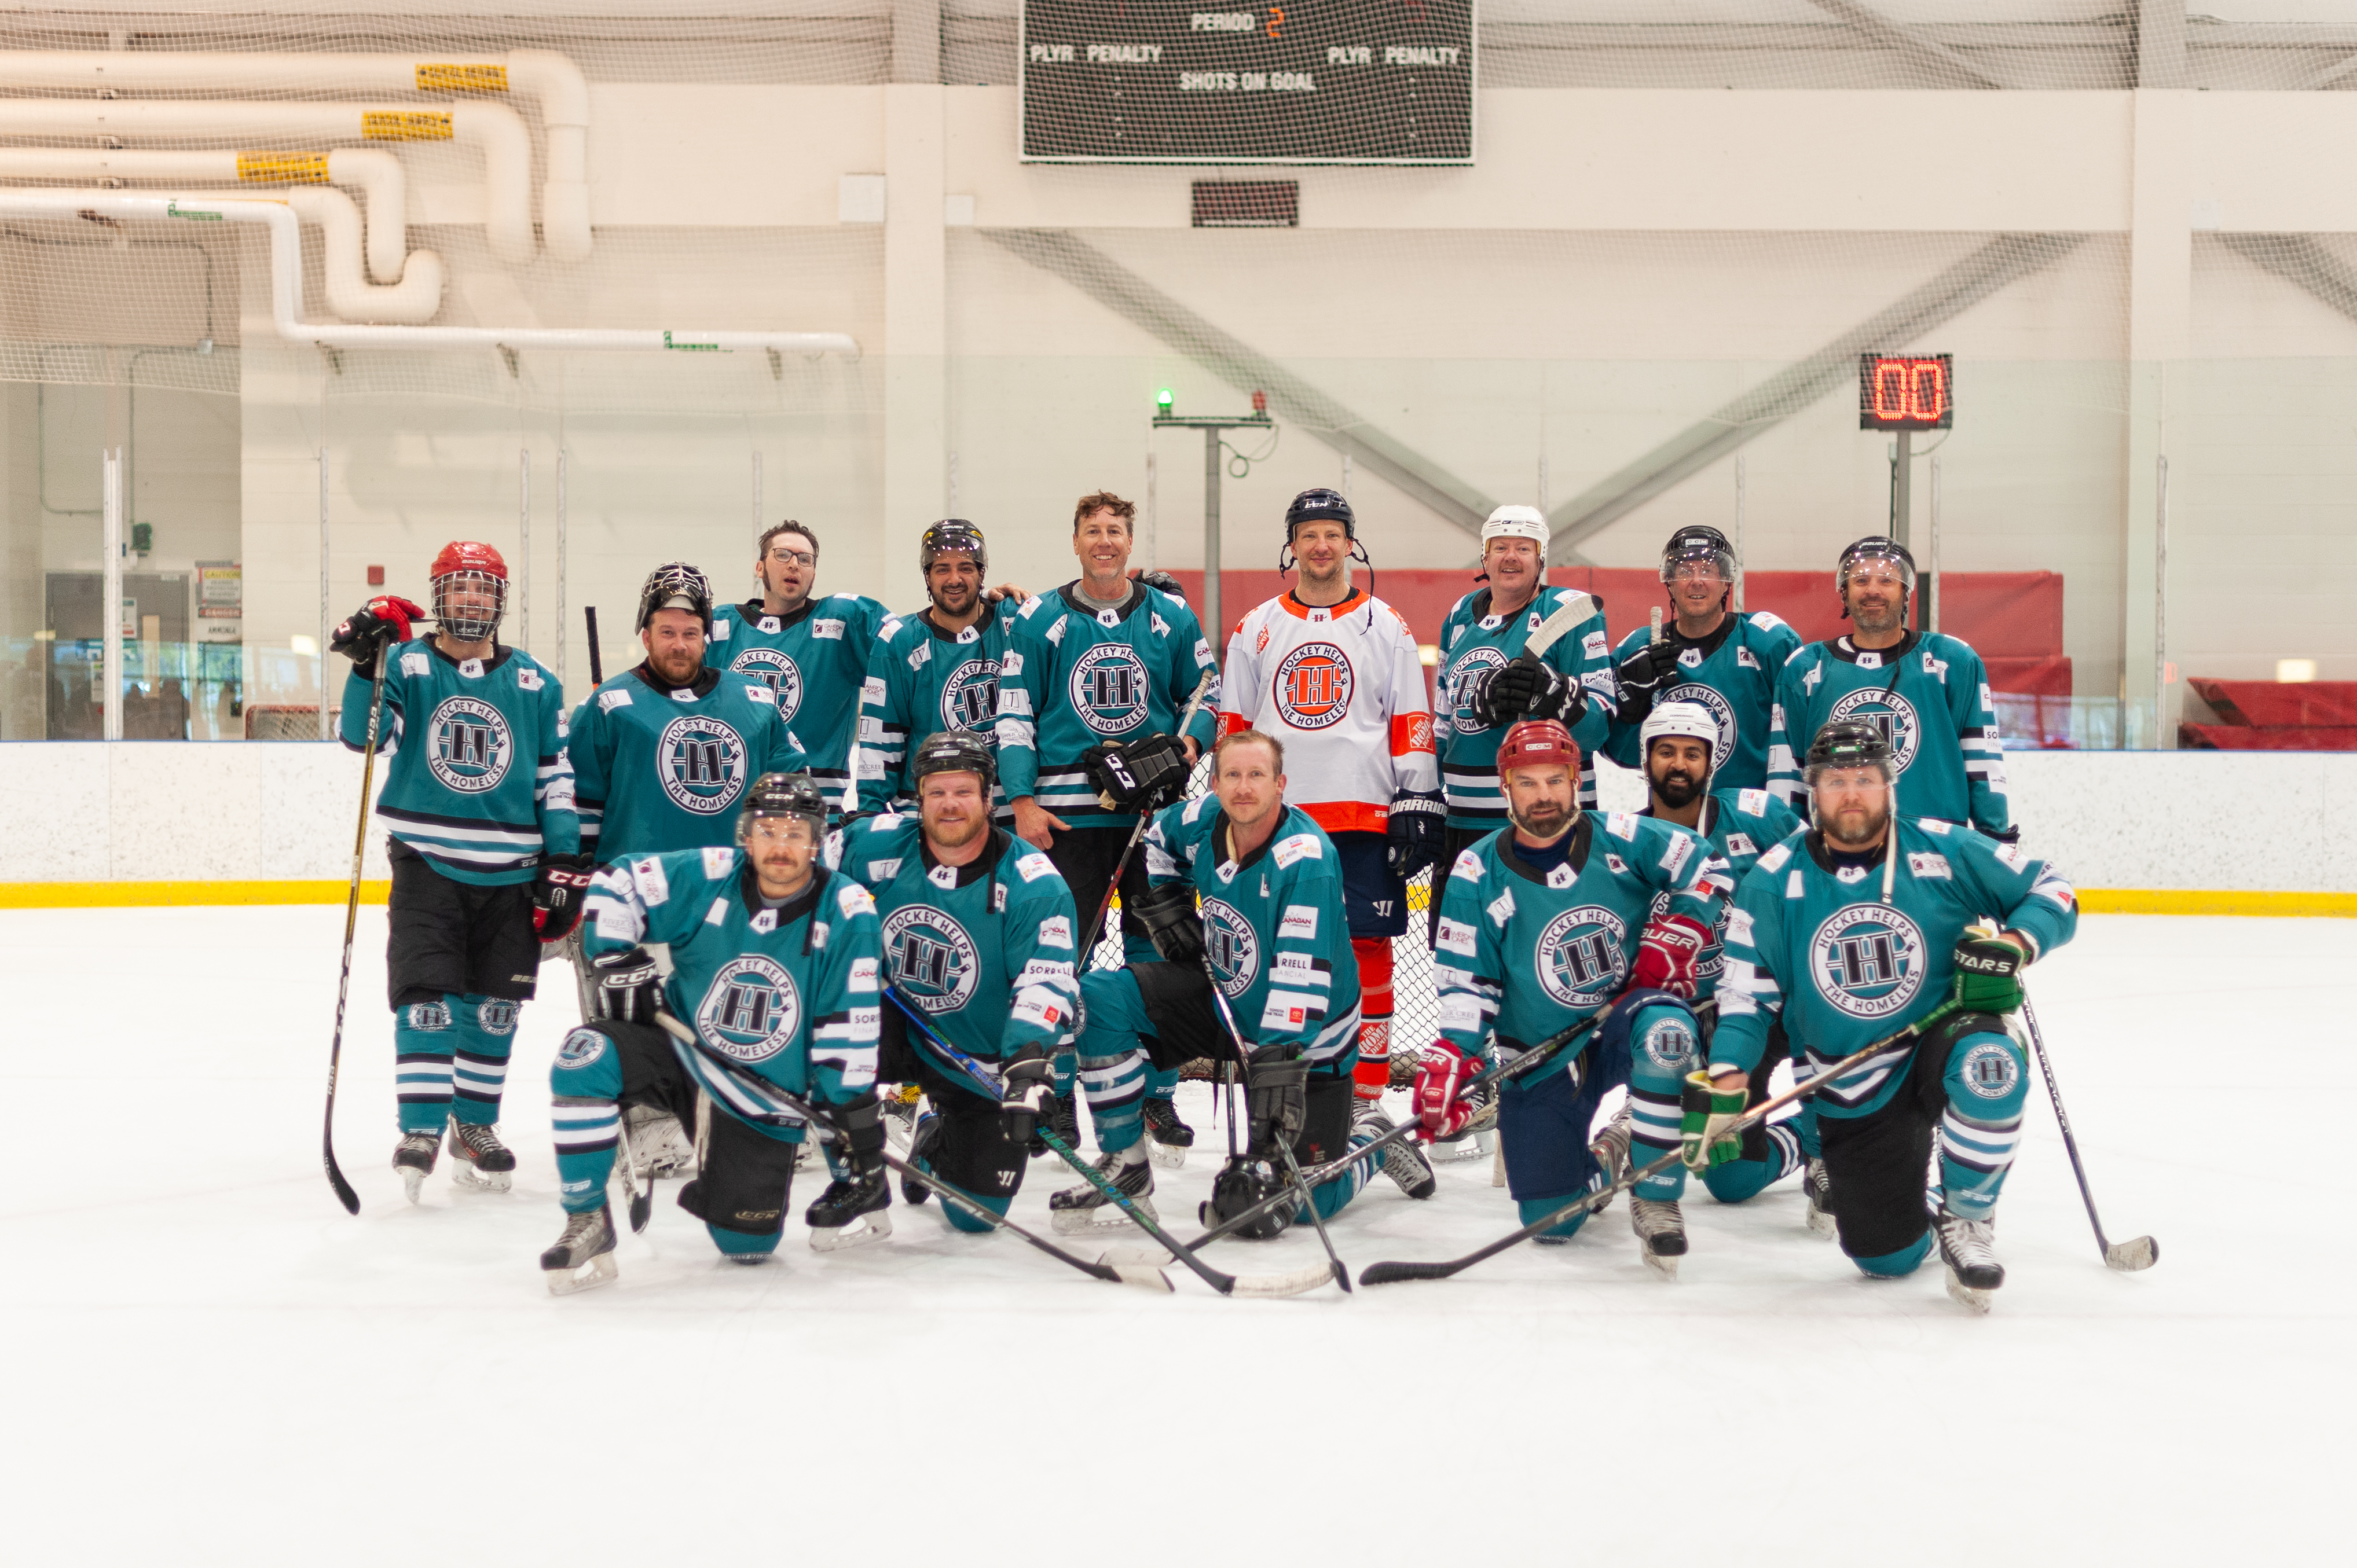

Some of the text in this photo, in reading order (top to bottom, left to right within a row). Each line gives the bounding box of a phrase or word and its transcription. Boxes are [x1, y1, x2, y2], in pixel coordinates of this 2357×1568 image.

[1191, 13, 1255, 31] PERIOD
[1266, 8, 1285, 37] 2
[1030, 44, 1163, 63] PLYR PENALTY
[1328, 46, 1460, 65] PLYR PENALTY
[1179, 72, 1317, 91] SHOTS ON GOAL
[1876, 363, 1942, 420] 00
[734, 652, 796, 679] OCKEY HELPS
[1078, 648, 1141, 674] HOCKEY HEPS
[1281, 646, 1348, 675] HOCKEY HELPS
[1451, 651, 1504, 680] HOCKEY HELP
[948, 664, 1002, 697] HOCKEY HEL
[1079, 701, 1146, 730] THE HOMELES
[1281, 702, 1296, 721] THE
[1668, 688, 1727, 715] CKEY HELPS
[1833, 692, 1876, 722] HOCKEY
[368, 707, 378, 741] CCM
[435, 702, 505, 735] HOCKEY HELPS
[1411, 717, 1431, 748] HOME
[1412, 718, 1424, 732] THE
[666, 720, 738, 747] HOCKEY HELPS
[432, 755, 504, 788] THE HOMELESS
[667, 776, 742, 809] THE HOMELESS
[548, 870, 592, 887] CC
[888, 911, 972, 959] HOCKEY HELPS
[1224, 909, 1252, 943] HELPS
[1450, 929, 1473, 941] AMERON
[1542, 910, 1621, 956] HOCKEY HELPS
[1642, 928, 1696, 950] AUER
[1818, 908, 1912, 949] HOCKEY HELPS
[1029, 965, 1071, 976] SORRELL
[1281, 958, 1307, 970] RRELL
[1953, 949, 2012, 974] STARS
[721, 960, 793, 998] HOKEY HELPS
[1226, 971, 1249, 993] ELESS
[1555, 955, 1624, 1004] THE HOLESS
[1827, 969, 1920, 1013] THE HOMELESS
[911, 989, 966, 1009] OMELESS
[699, 1016, 788, 1057] THE HOMELESS
[1358, 1021, 1390, 1052] HOME
[1361, 1024, 1376, 1038] THE
